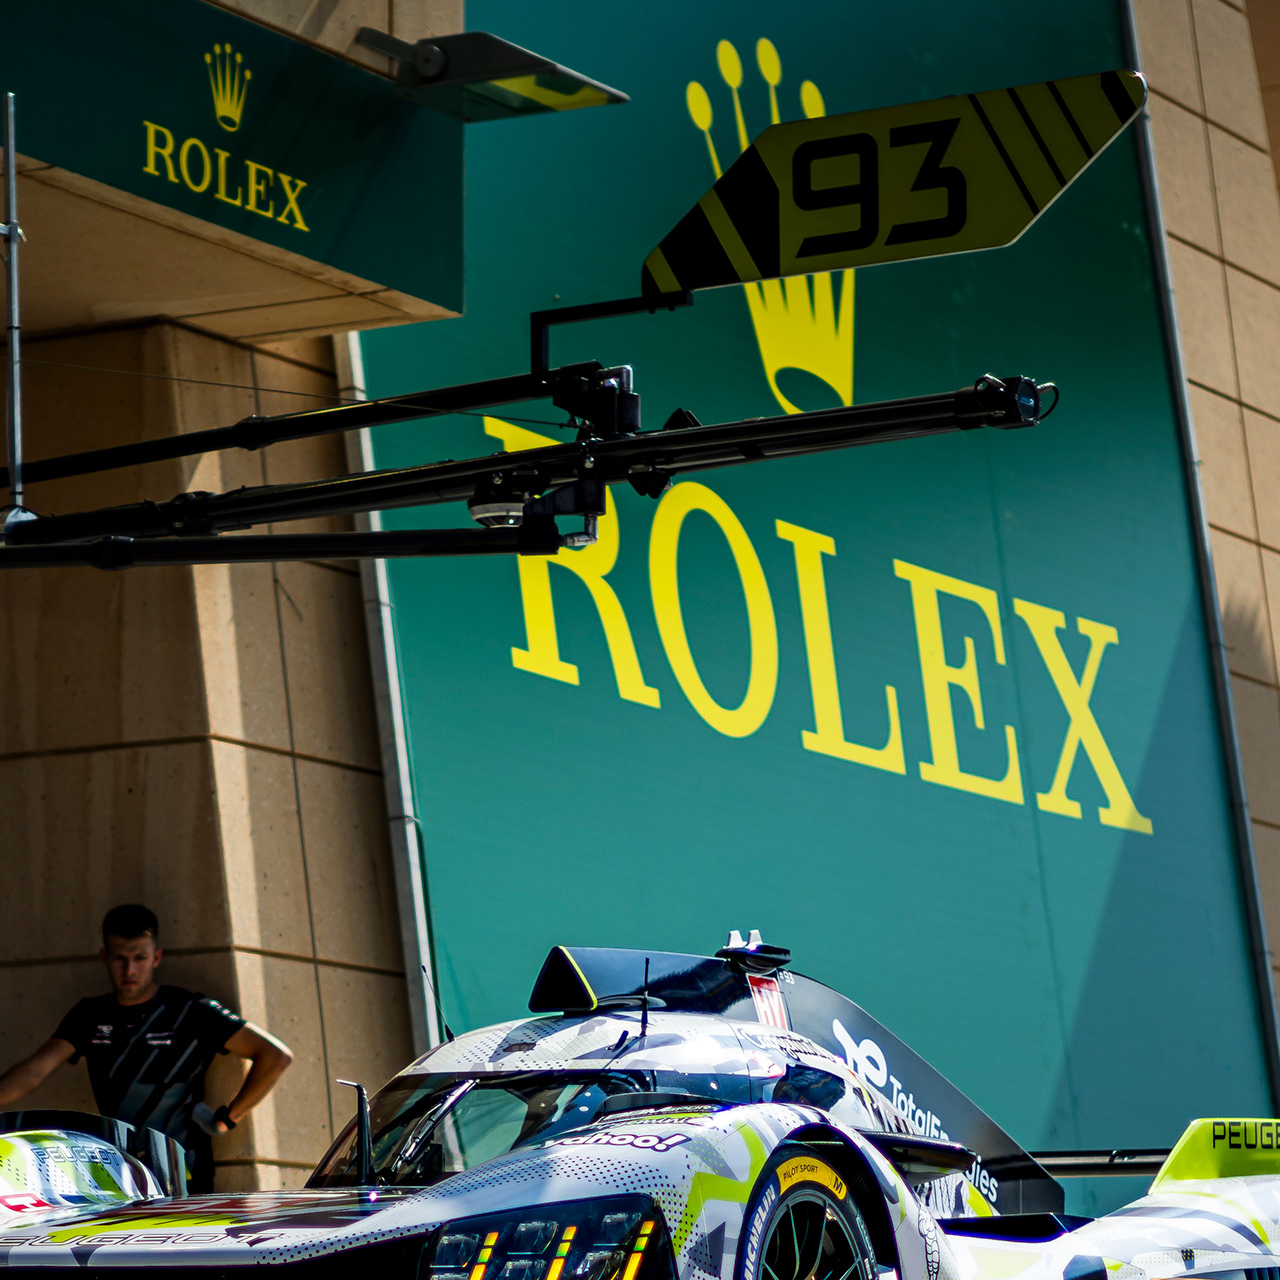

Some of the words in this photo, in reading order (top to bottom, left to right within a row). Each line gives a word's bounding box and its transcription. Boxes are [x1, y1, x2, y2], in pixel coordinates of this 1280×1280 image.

[142, 120, 311, 232] ROLEX
[792, 117, 967, 259] 93
[483, 416, 1153, 834] ROLEX
[542, 1133, 692, 1153] yahoo!
[32, 1146, 120, 1165] PEUGEOT
[783, 1165, 799, 1181] PILOT
[800, 1164, 819, 1173] SPORT
[833, 1177, 843, 1194] M
